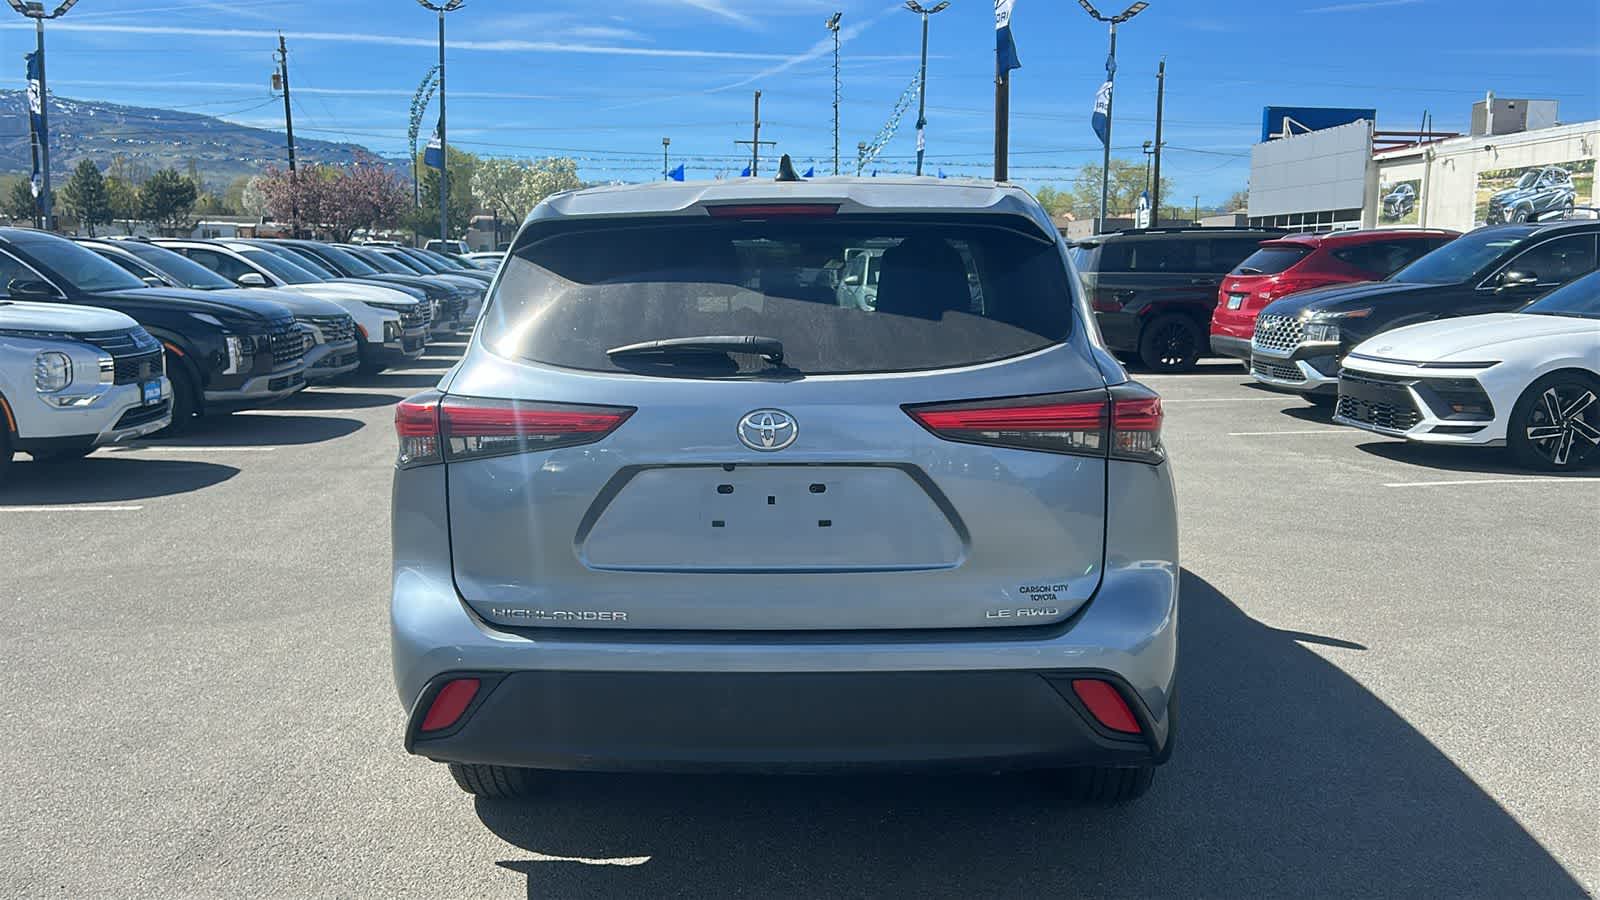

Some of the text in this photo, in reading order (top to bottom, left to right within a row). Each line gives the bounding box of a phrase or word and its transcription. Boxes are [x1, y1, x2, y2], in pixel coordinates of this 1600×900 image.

[1019, 584, 1069, 594] CARSON CITY
[1030, 593, 1057, 601] TOYOTA
[492, 608, 627, 621] HIGHLANDER
[985, 607, 1059, 619] LE AWD
